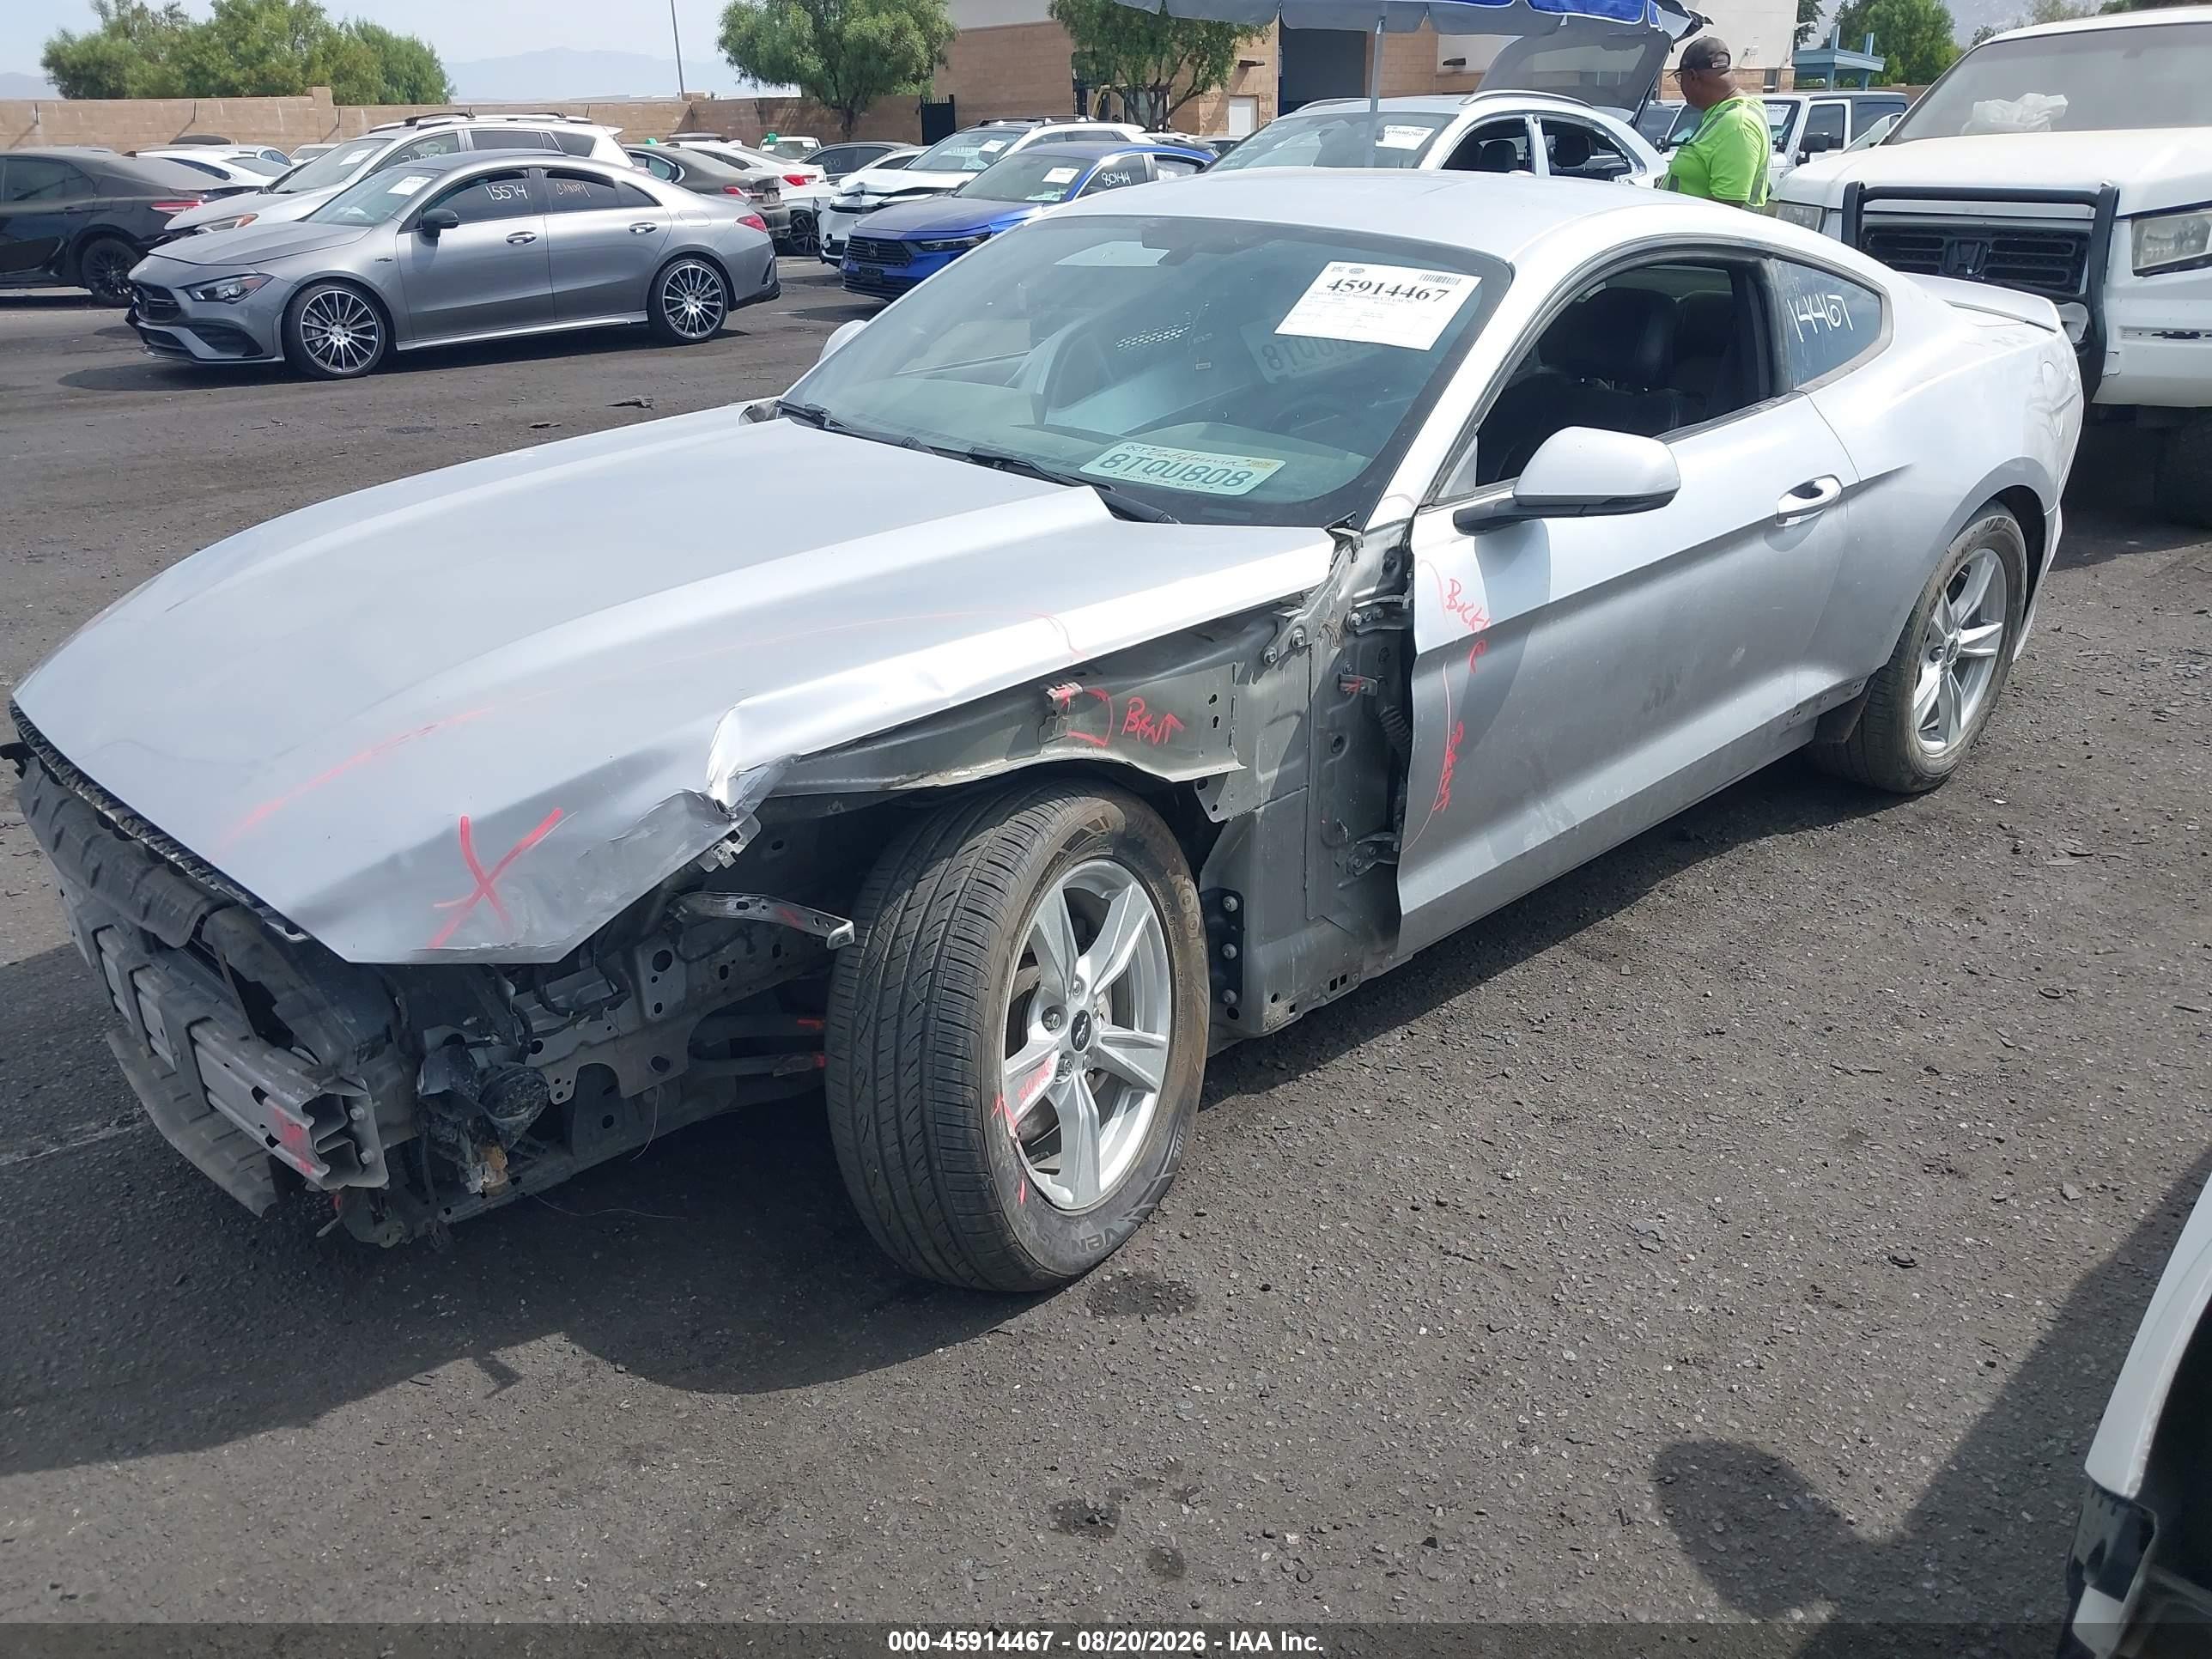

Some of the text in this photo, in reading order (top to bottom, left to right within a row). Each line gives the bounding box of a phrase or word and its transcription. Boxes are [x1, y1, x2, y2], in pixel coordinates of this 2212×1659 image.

[485, 185, 528, 201] 15574
[1327, 278, 1451, 302] 45914467
[1787, 293, 1853, 343] 14467
[1126, 445, 1146, 454] OCT
[1145, 447, 1237, 467] California
[1099, 453, 1254, 487] 8TQU808
